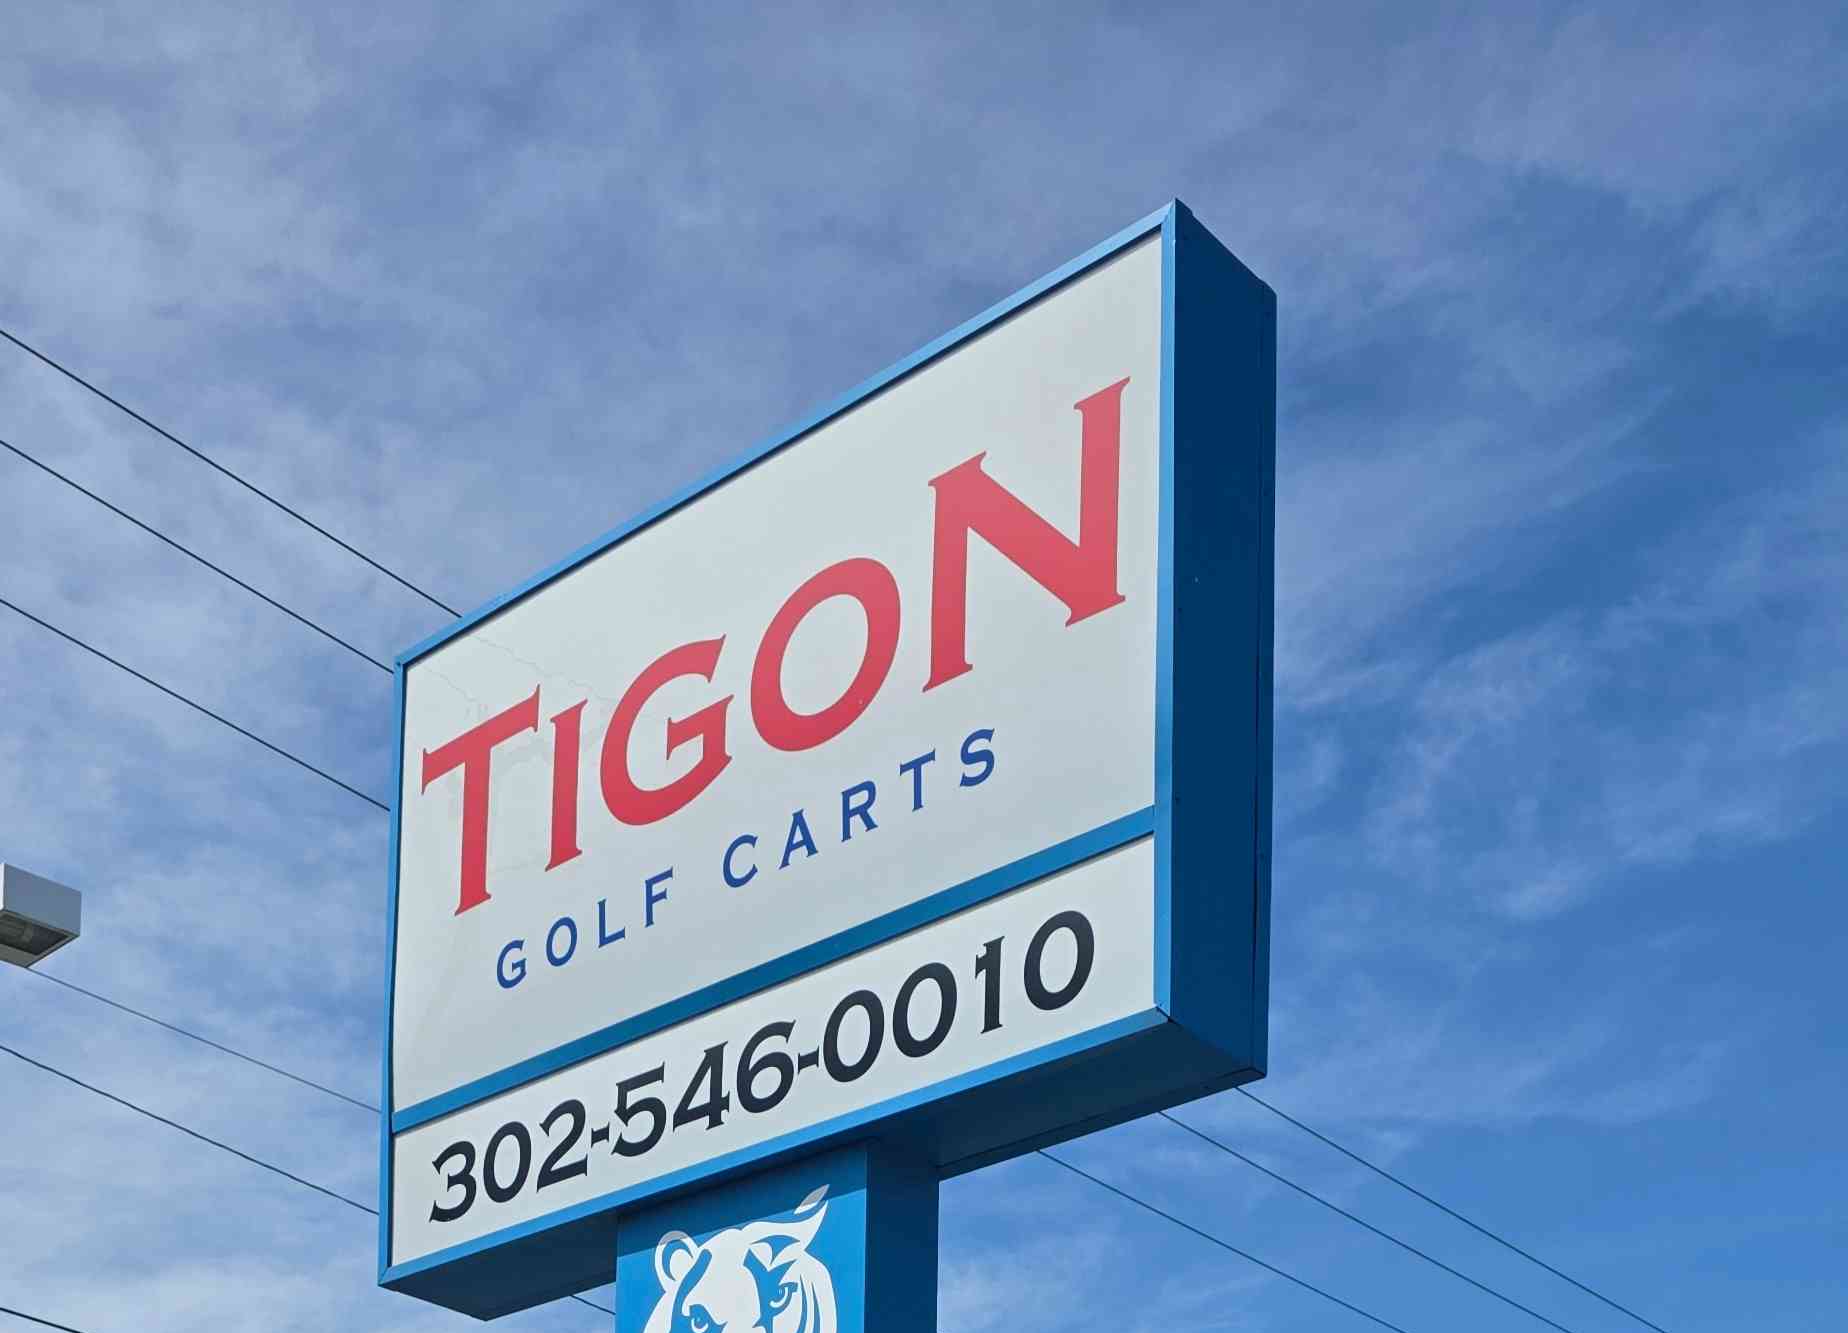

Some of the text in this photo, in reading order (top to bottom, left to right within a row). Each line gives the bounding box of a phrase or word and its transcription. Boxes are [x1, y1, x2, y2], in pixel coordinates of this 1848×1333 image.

[420, 377, 1130, 914] TIGON
[497, 728, 995, 990] GOLF CARTS
[429, 910, 1095, 1223] 302-546-0010
